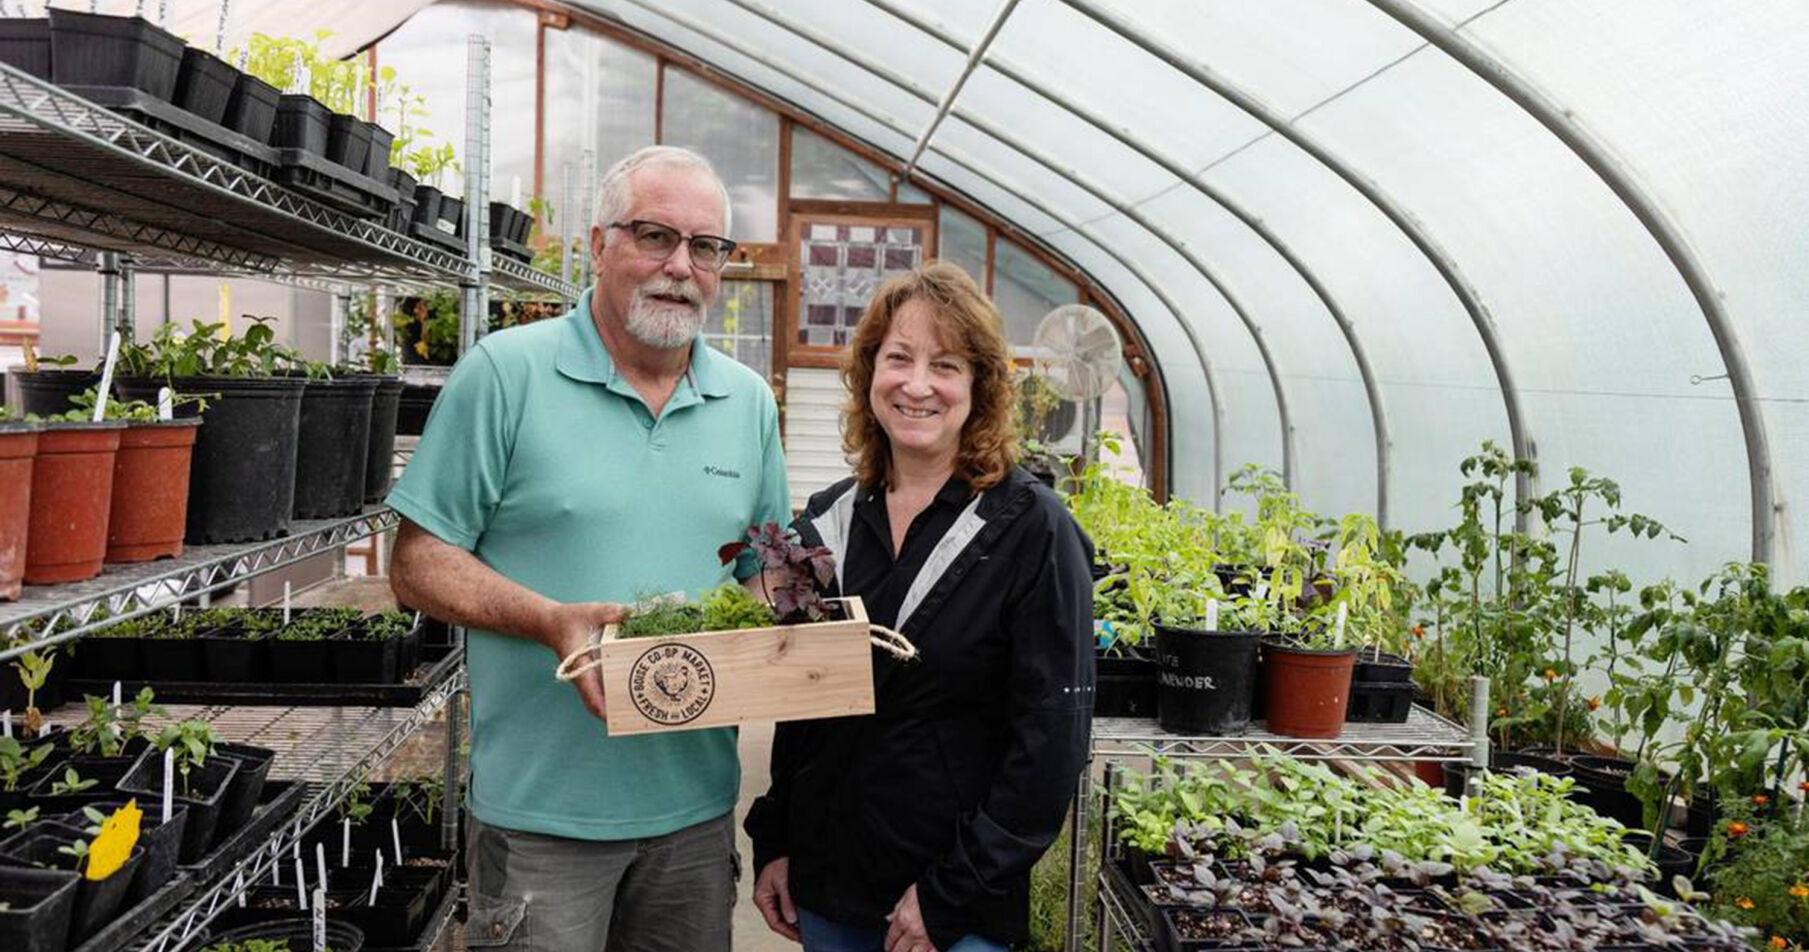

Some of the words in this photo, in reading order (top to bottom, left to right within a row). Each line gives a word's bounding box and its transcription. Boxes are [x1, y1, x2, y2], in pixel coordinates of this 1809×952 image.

[634, 662, 650, 691] BOISE
[647, 647, 678, 664] CO-OP
[681, 650, 710, 685] MARKET
[639, 697, 669, 720] FRESH
[681, 695, 707, 719] LOCAL
